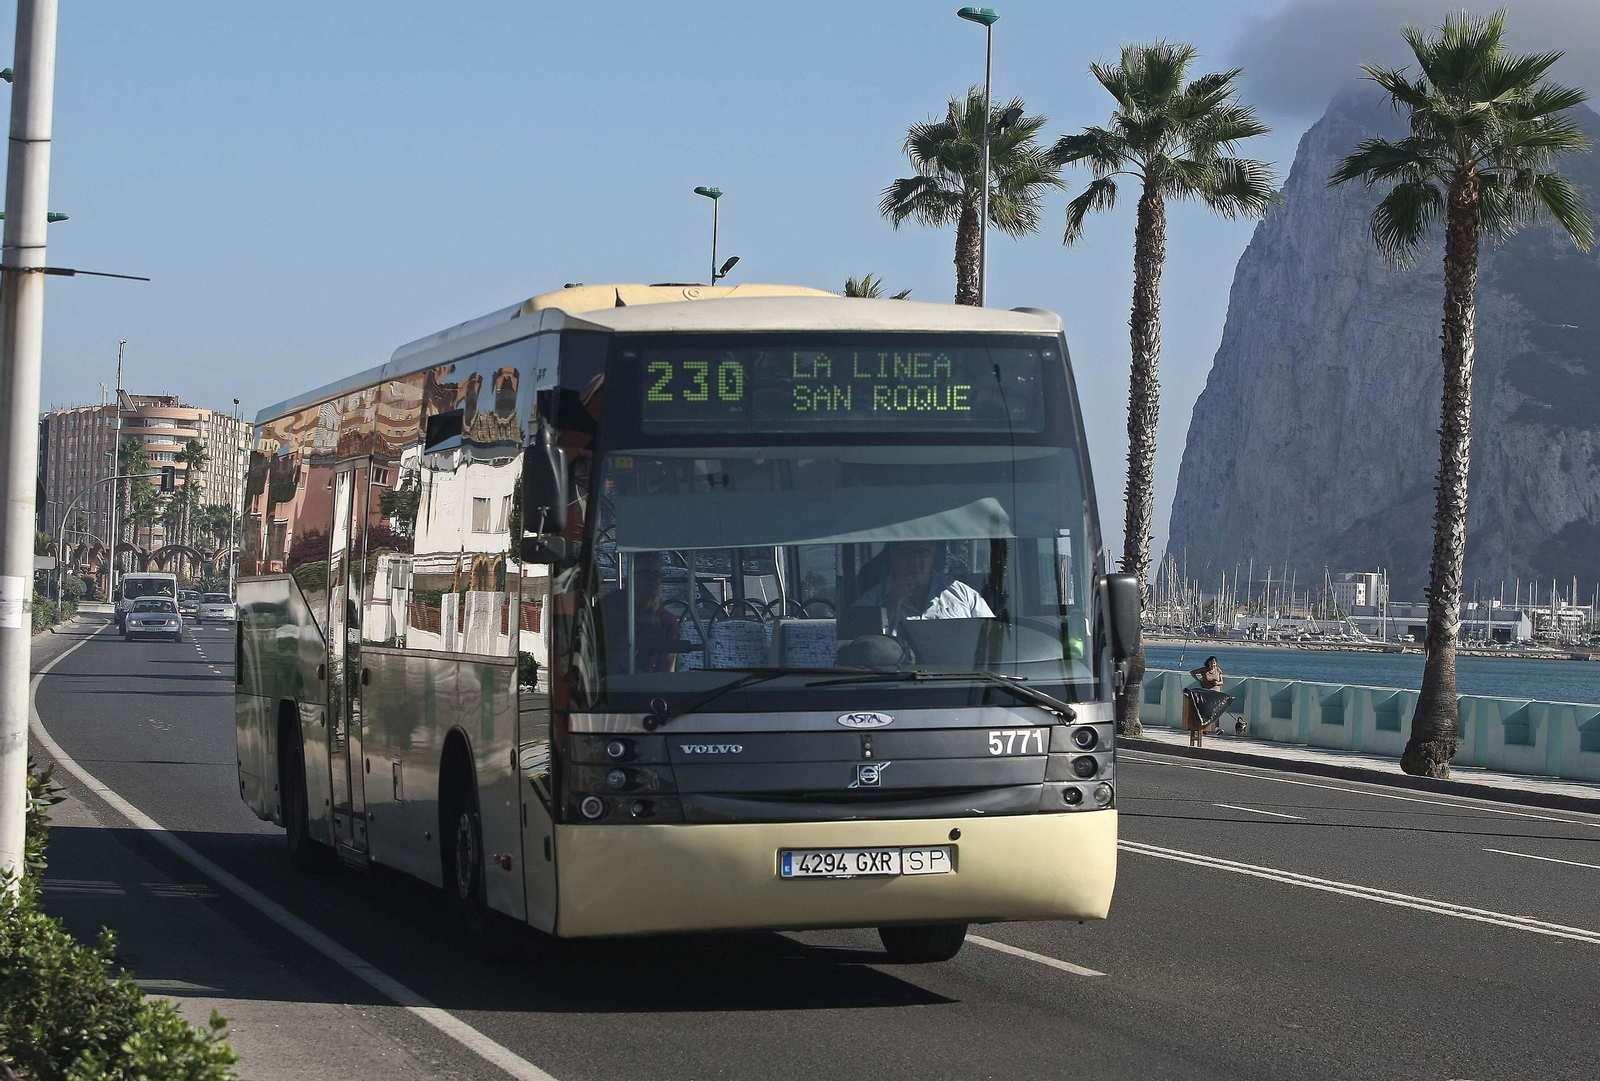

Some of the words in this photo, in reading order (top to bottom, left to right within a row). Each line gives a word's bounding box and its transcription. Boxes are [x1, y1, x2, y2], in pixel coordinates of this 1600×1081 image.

[793, 352, 832, 378] LA
[853, 352, 952, 378] LINEA
[647, 360, 744, 401] 230
[793, 385, 852, 411] SAN
[873, 385, 971, 411] ROQUE
[680, 744, 743, 754] VOLVO
[988, 729, 1043, 755] 5771
[799, 854, 848, 873] 4294
[856, 852, 892, 872] GXR
